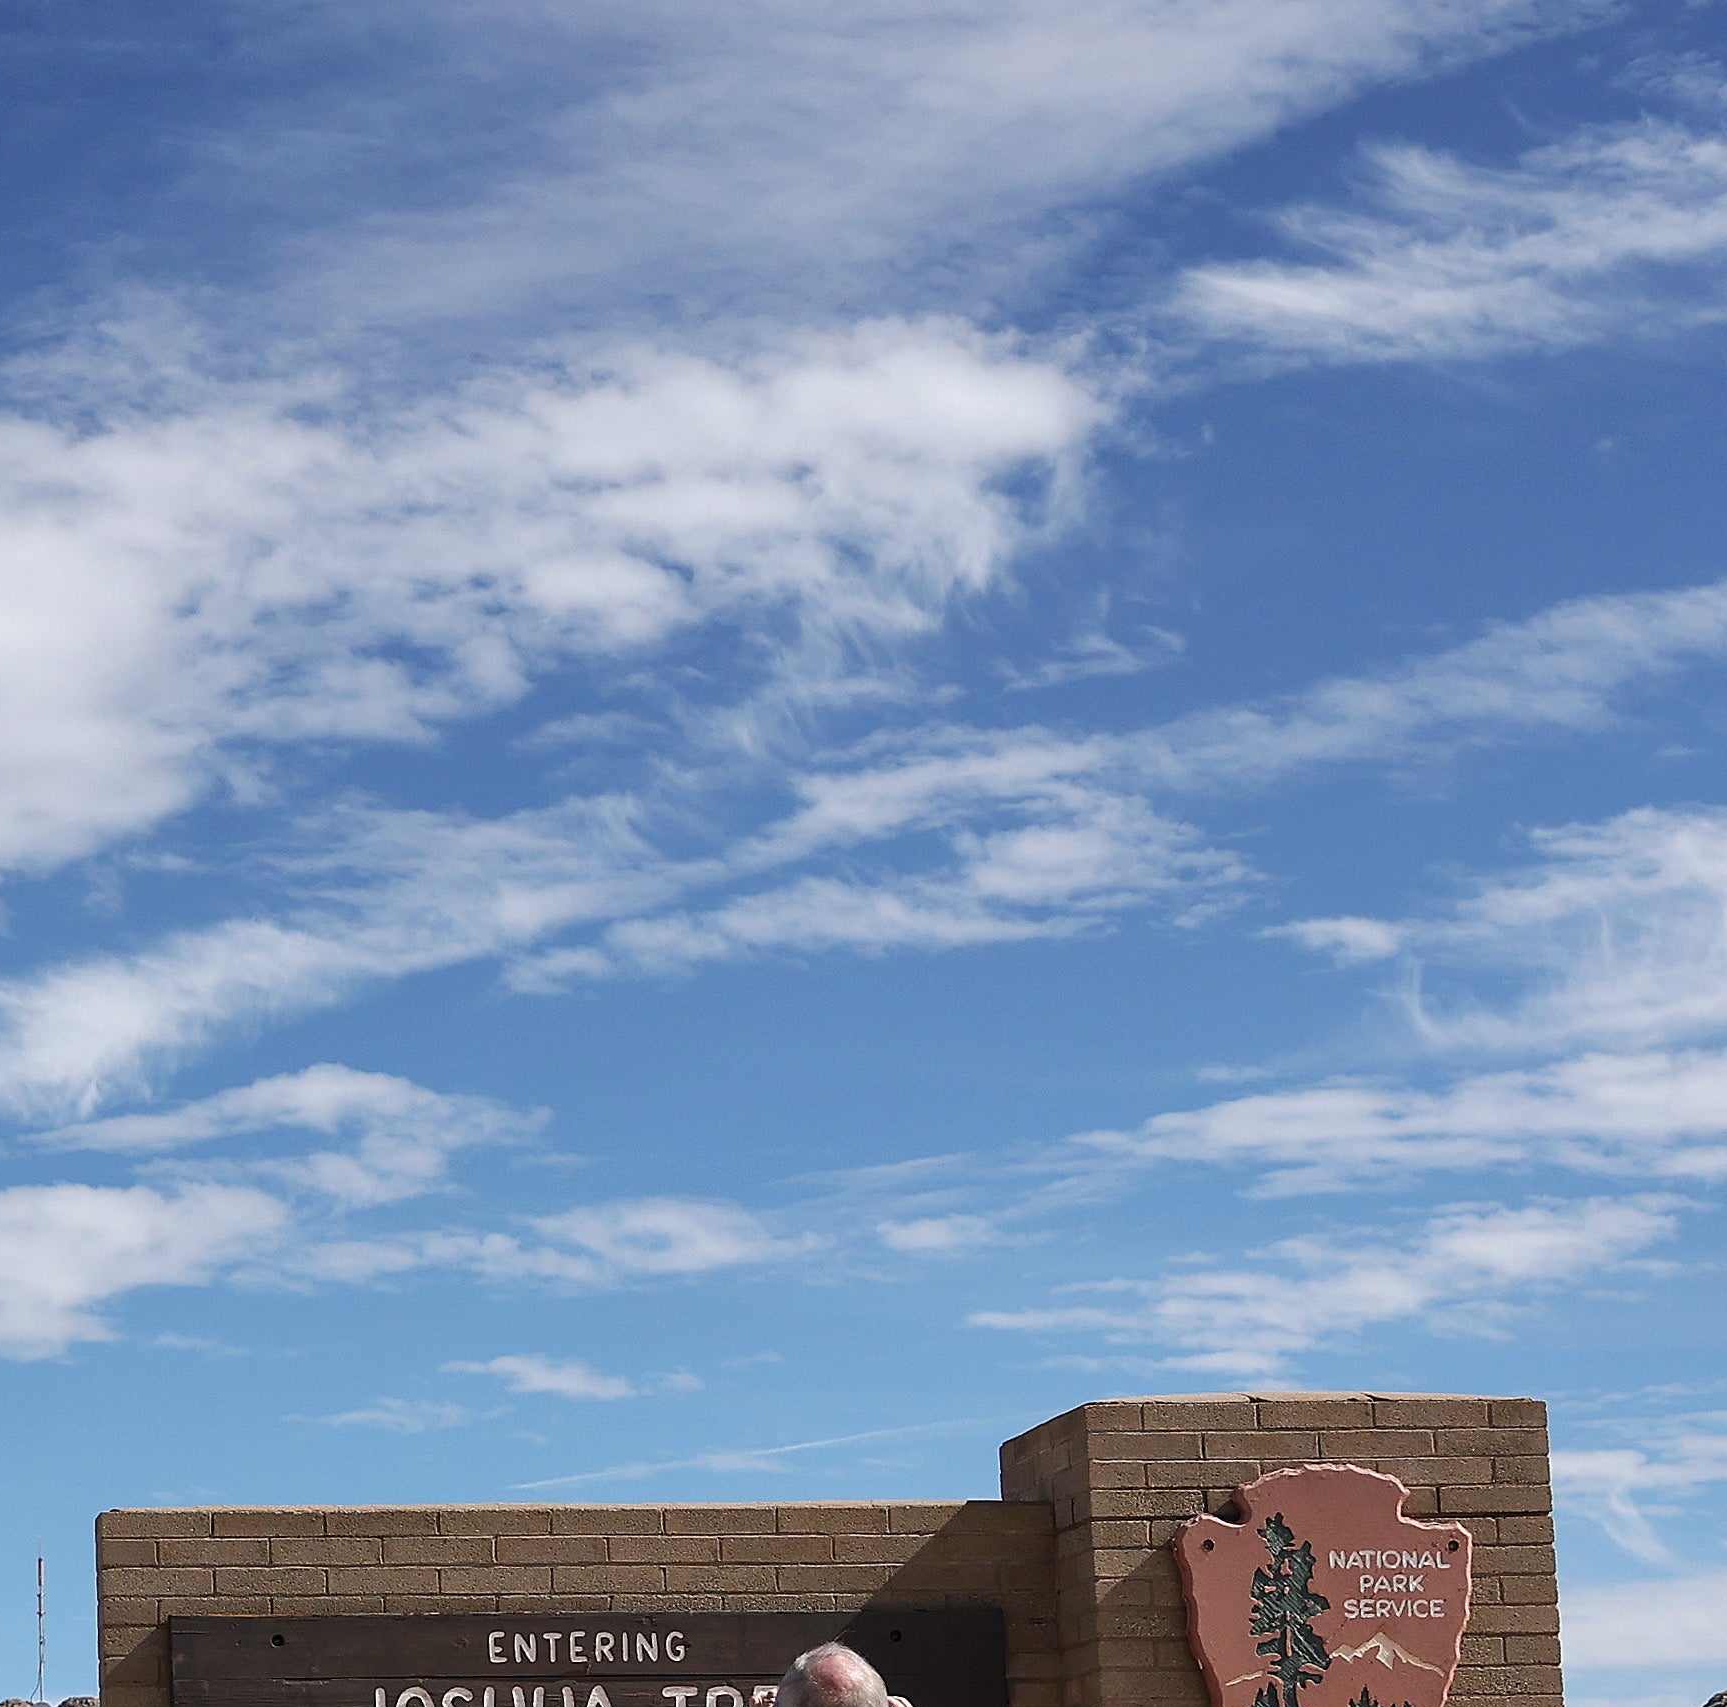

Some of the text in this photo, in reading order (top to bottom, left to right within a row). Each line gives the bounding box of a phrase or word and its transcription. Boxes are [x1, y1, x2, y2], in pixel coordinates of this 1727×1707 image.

[1327, 1549, 1451, 1570] NATIONAL
[1358, 1573, 1424, 1594] PARK
[1342, 1598, 1445, 1619] SERVICE
[487, 1630, 687, 1663] ENTERING
